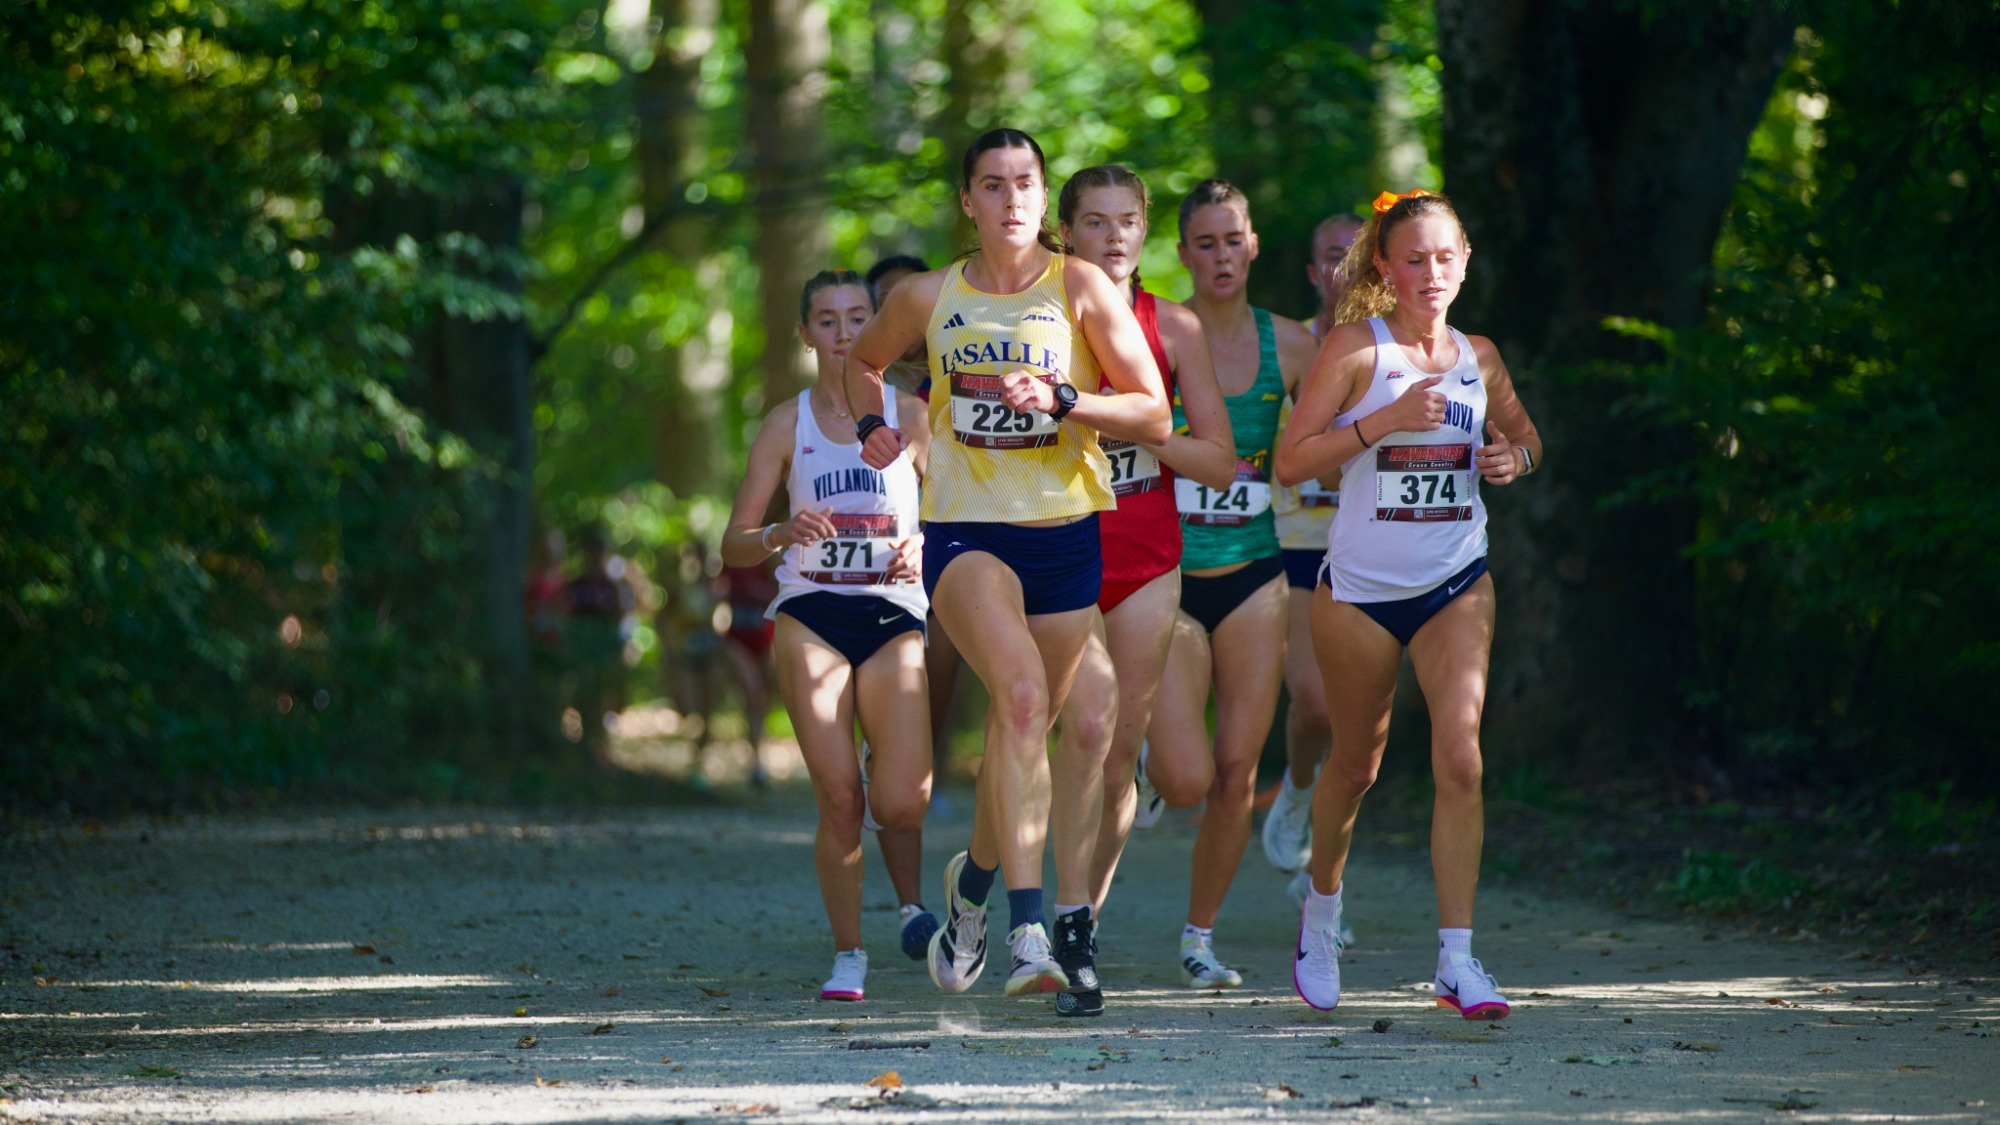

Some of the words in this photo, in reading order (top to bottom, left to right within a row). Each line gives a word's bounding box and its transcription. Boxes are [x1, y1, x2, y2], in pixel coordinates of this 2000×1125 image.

[940, 341, 1059, 377] LASALLE
[972, 403, 1034, 433] 225
[1105, 449, 1137, 483] 37
[1389, 446, 1465, 461] HAVERFORD
[813, 468, 887, 502] VILLANOVA
[1196, 485, 1249, 511] 124
[1400, 474, 1456, 505] 374
[832, 515, 890, 529] VERFORD
[821, 541, 872, 568] 371
